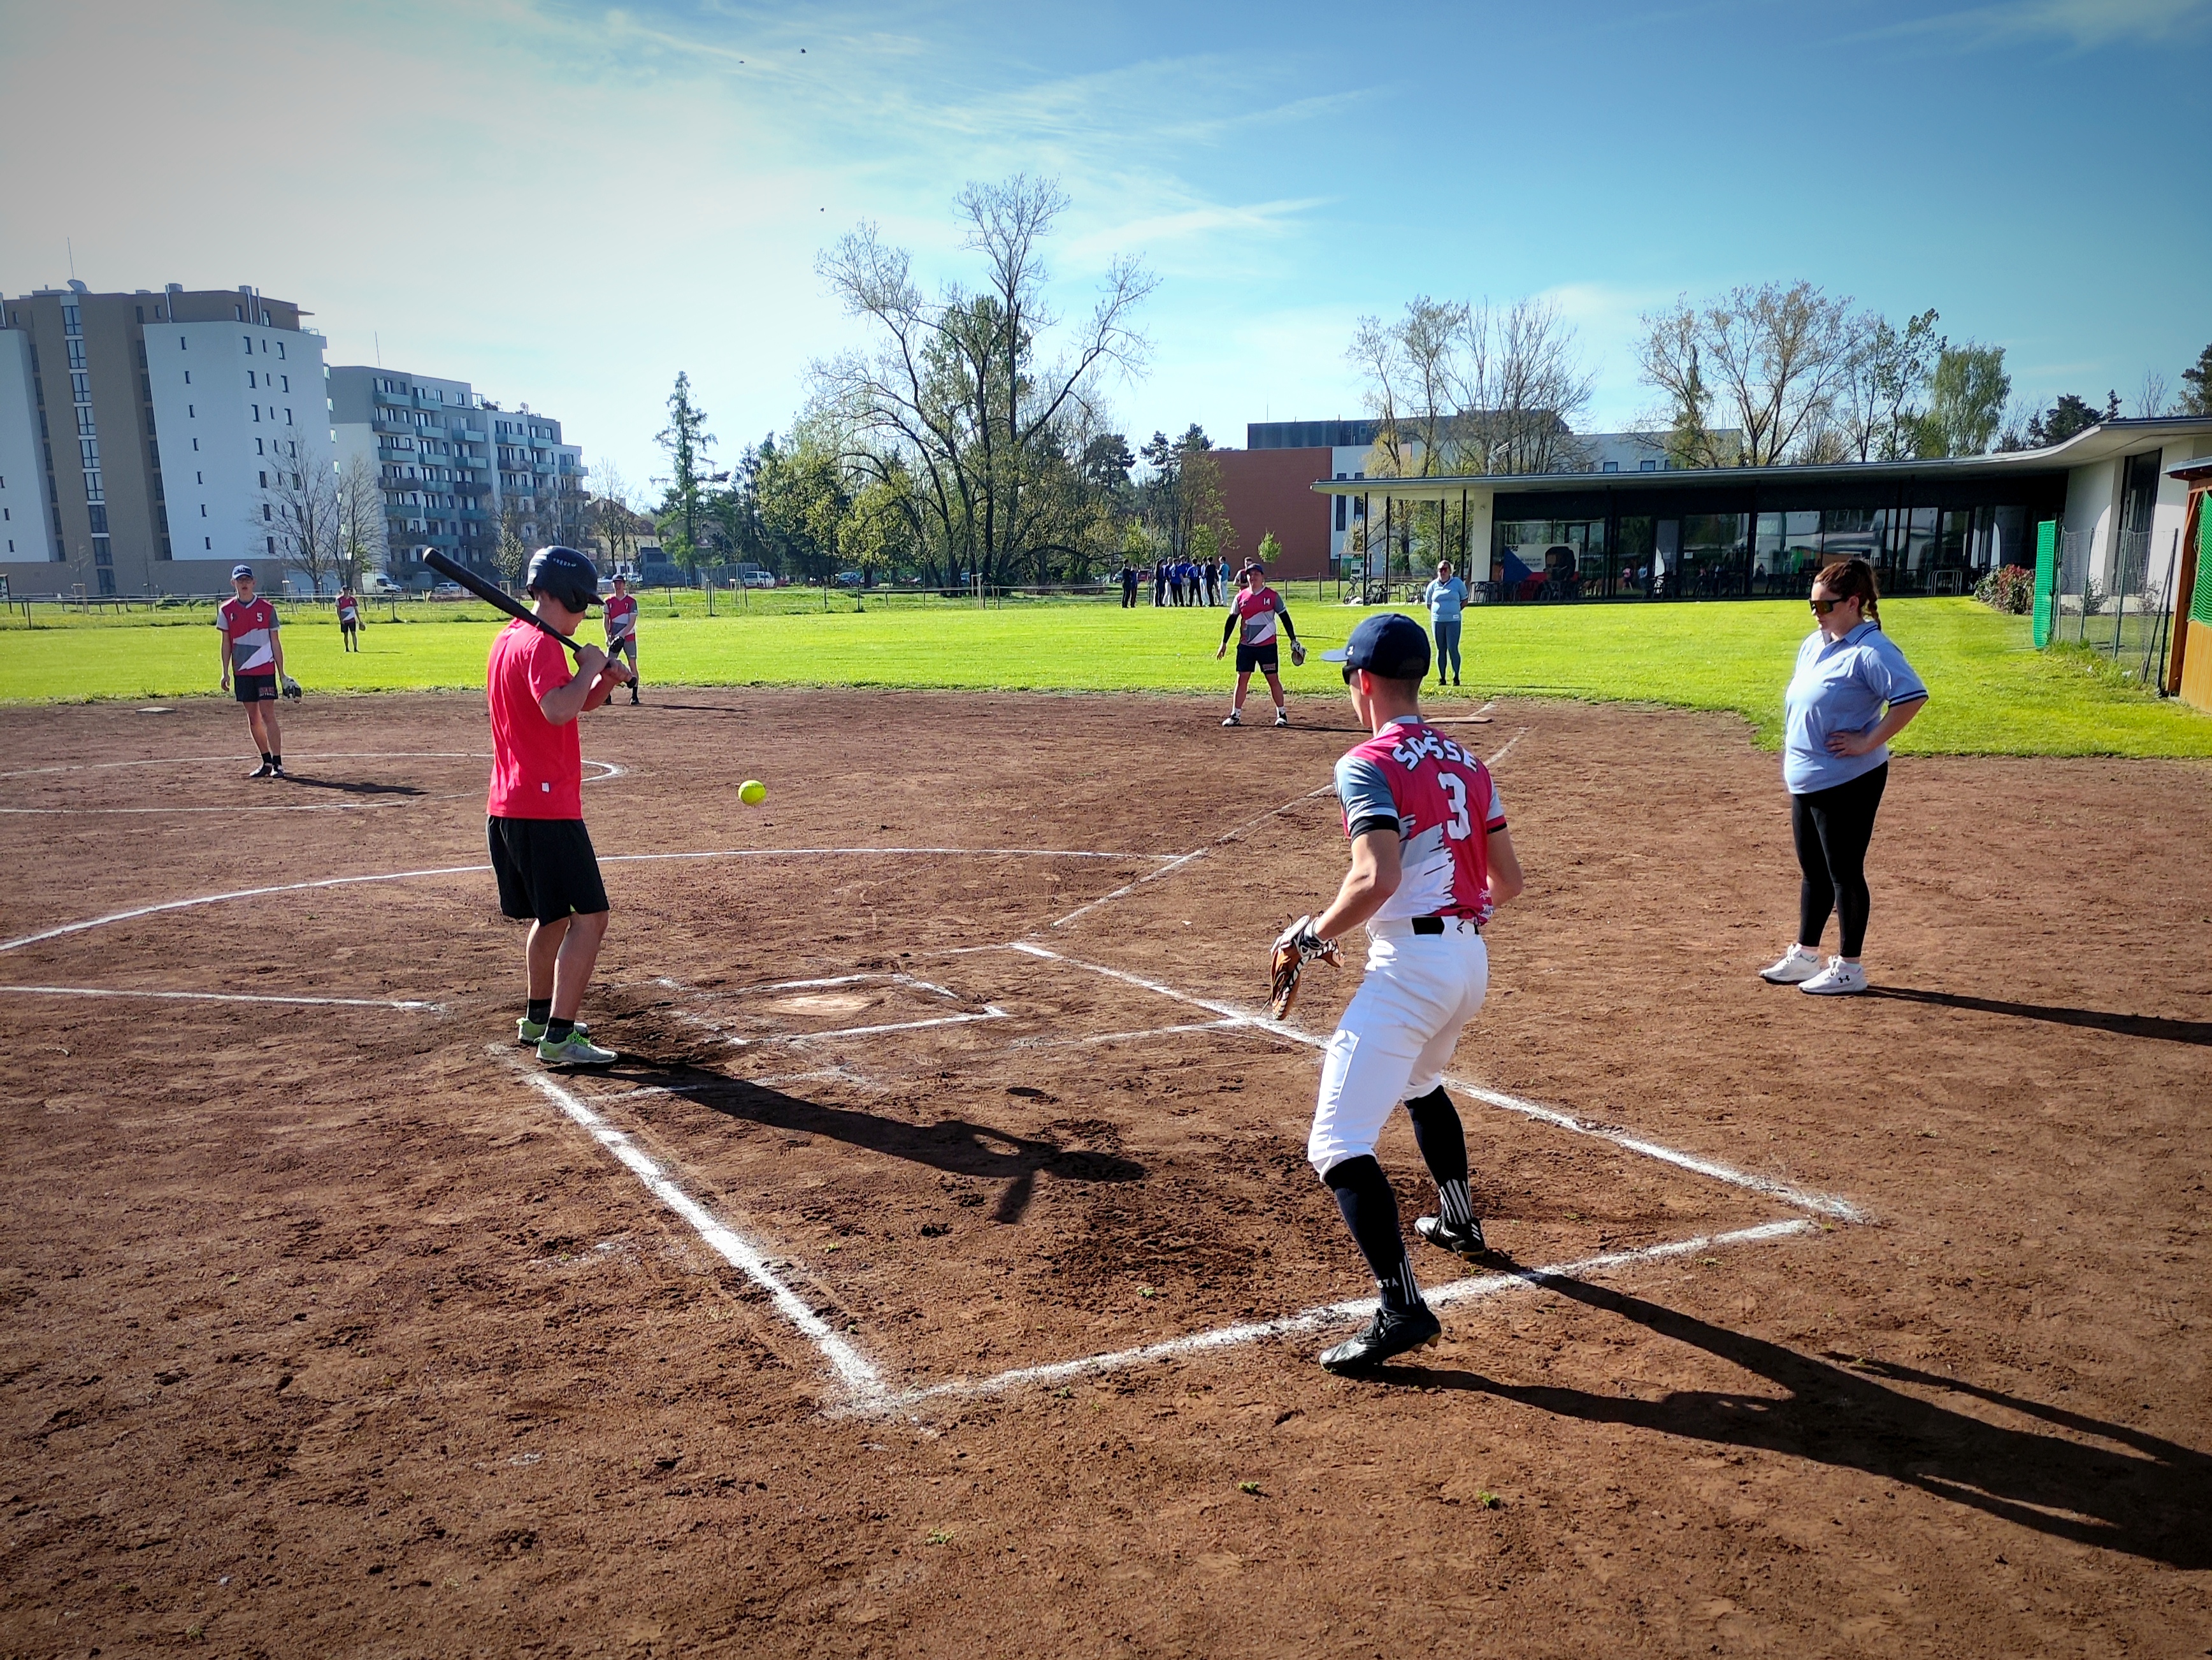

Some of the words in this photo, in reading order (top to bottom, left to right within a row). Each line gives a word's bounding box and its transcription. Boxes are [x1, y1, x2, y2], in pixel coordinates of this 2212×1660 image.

[1263, 597, 1270, 605] 14
[256, 612, 263, 622] 5
[1437, 771, 1472, 841] 3
